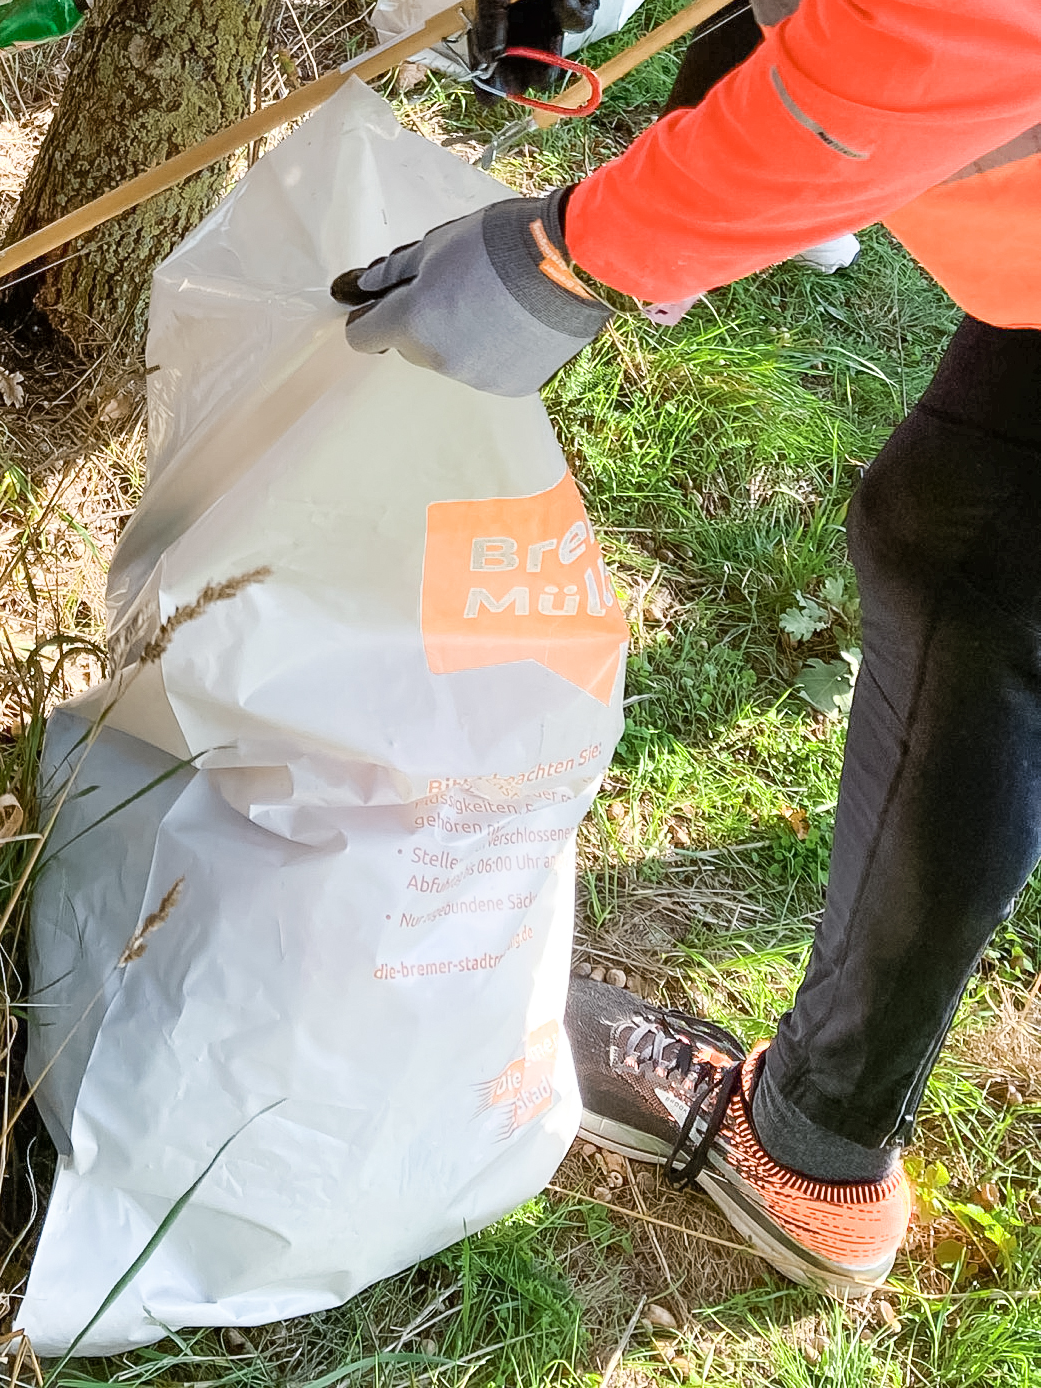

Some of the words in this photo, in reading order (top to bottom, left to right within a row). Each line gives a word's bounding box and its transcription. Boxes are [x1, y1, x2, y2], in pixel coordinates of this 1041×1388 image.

[578, 741, 603, 767] Sie:
[414, 812, 483, 835] gehören
[411, 846, 463, 870] Stelle
[477, 856, 513, 874] 06:00
[515, 853, 541, 870] Uhr
